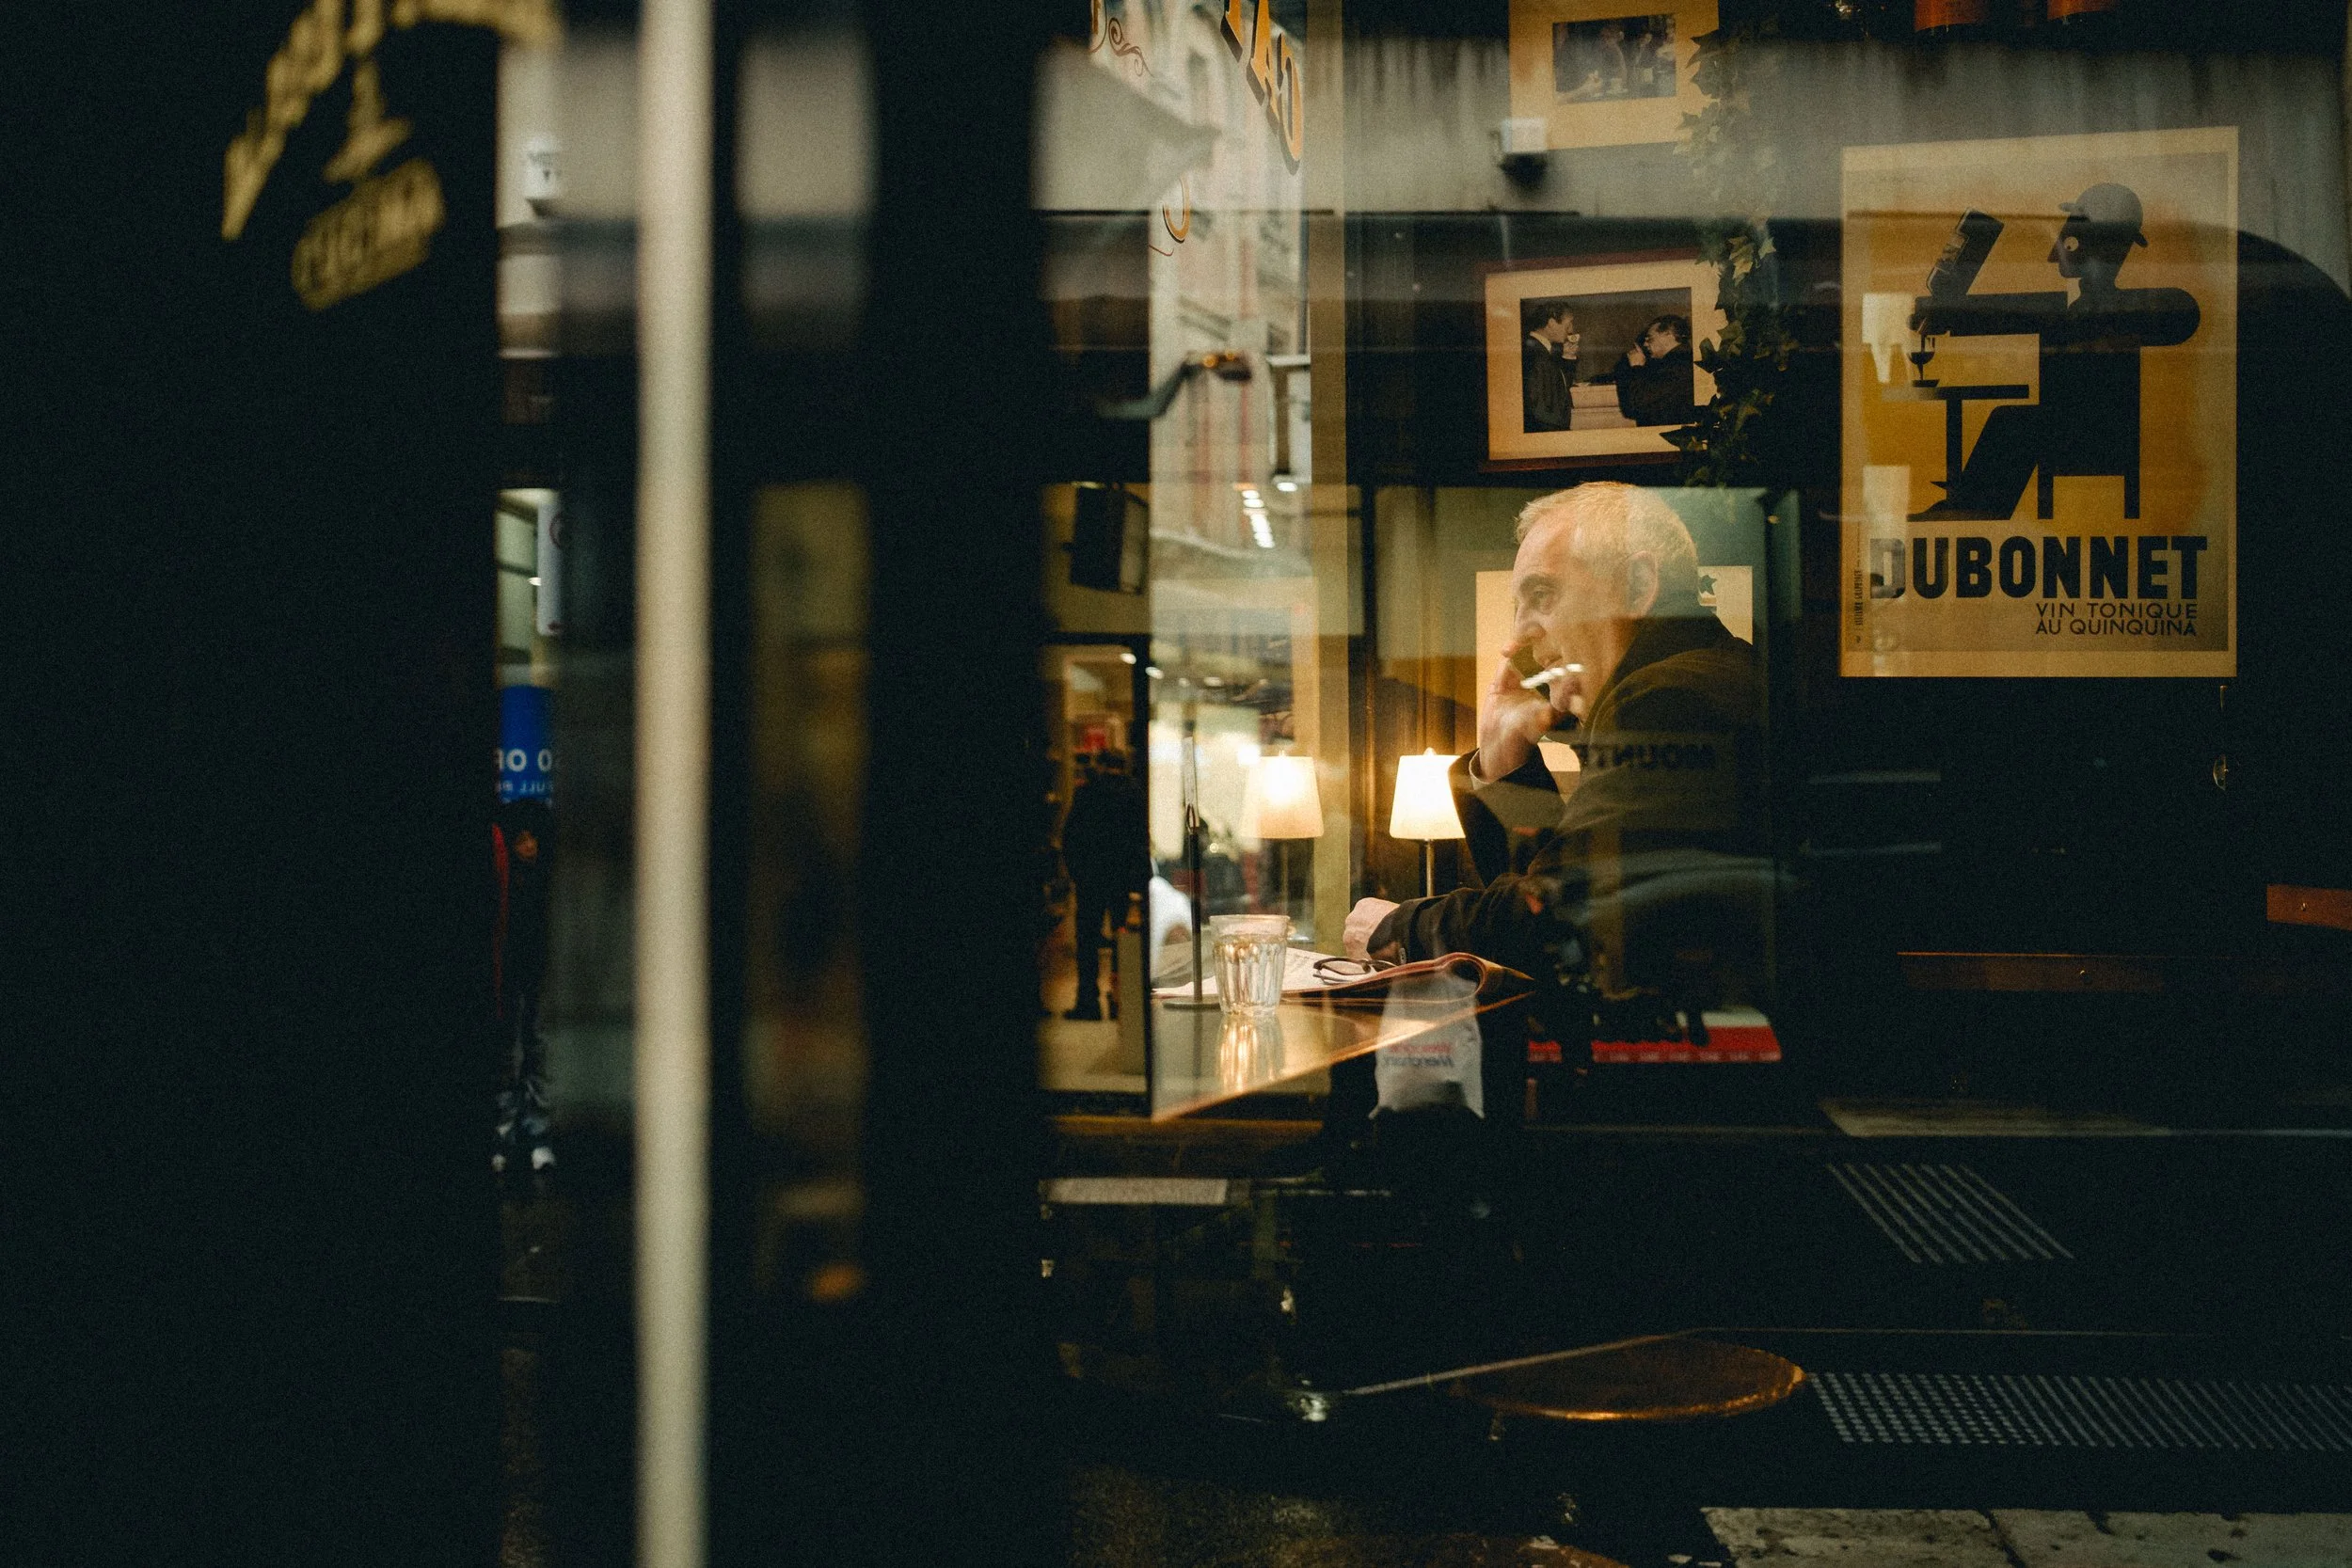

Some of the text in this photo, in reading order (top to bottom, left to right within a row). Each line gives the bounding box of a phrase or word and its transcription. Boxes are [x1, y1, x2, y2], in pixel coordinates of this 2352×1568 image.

[1869, 535, 2207, 600] DUBONNET
[2035, 602, 2199, 620] VIN TONIQUE
[2035, 618, 2198, 637] AU QUINQUINA
